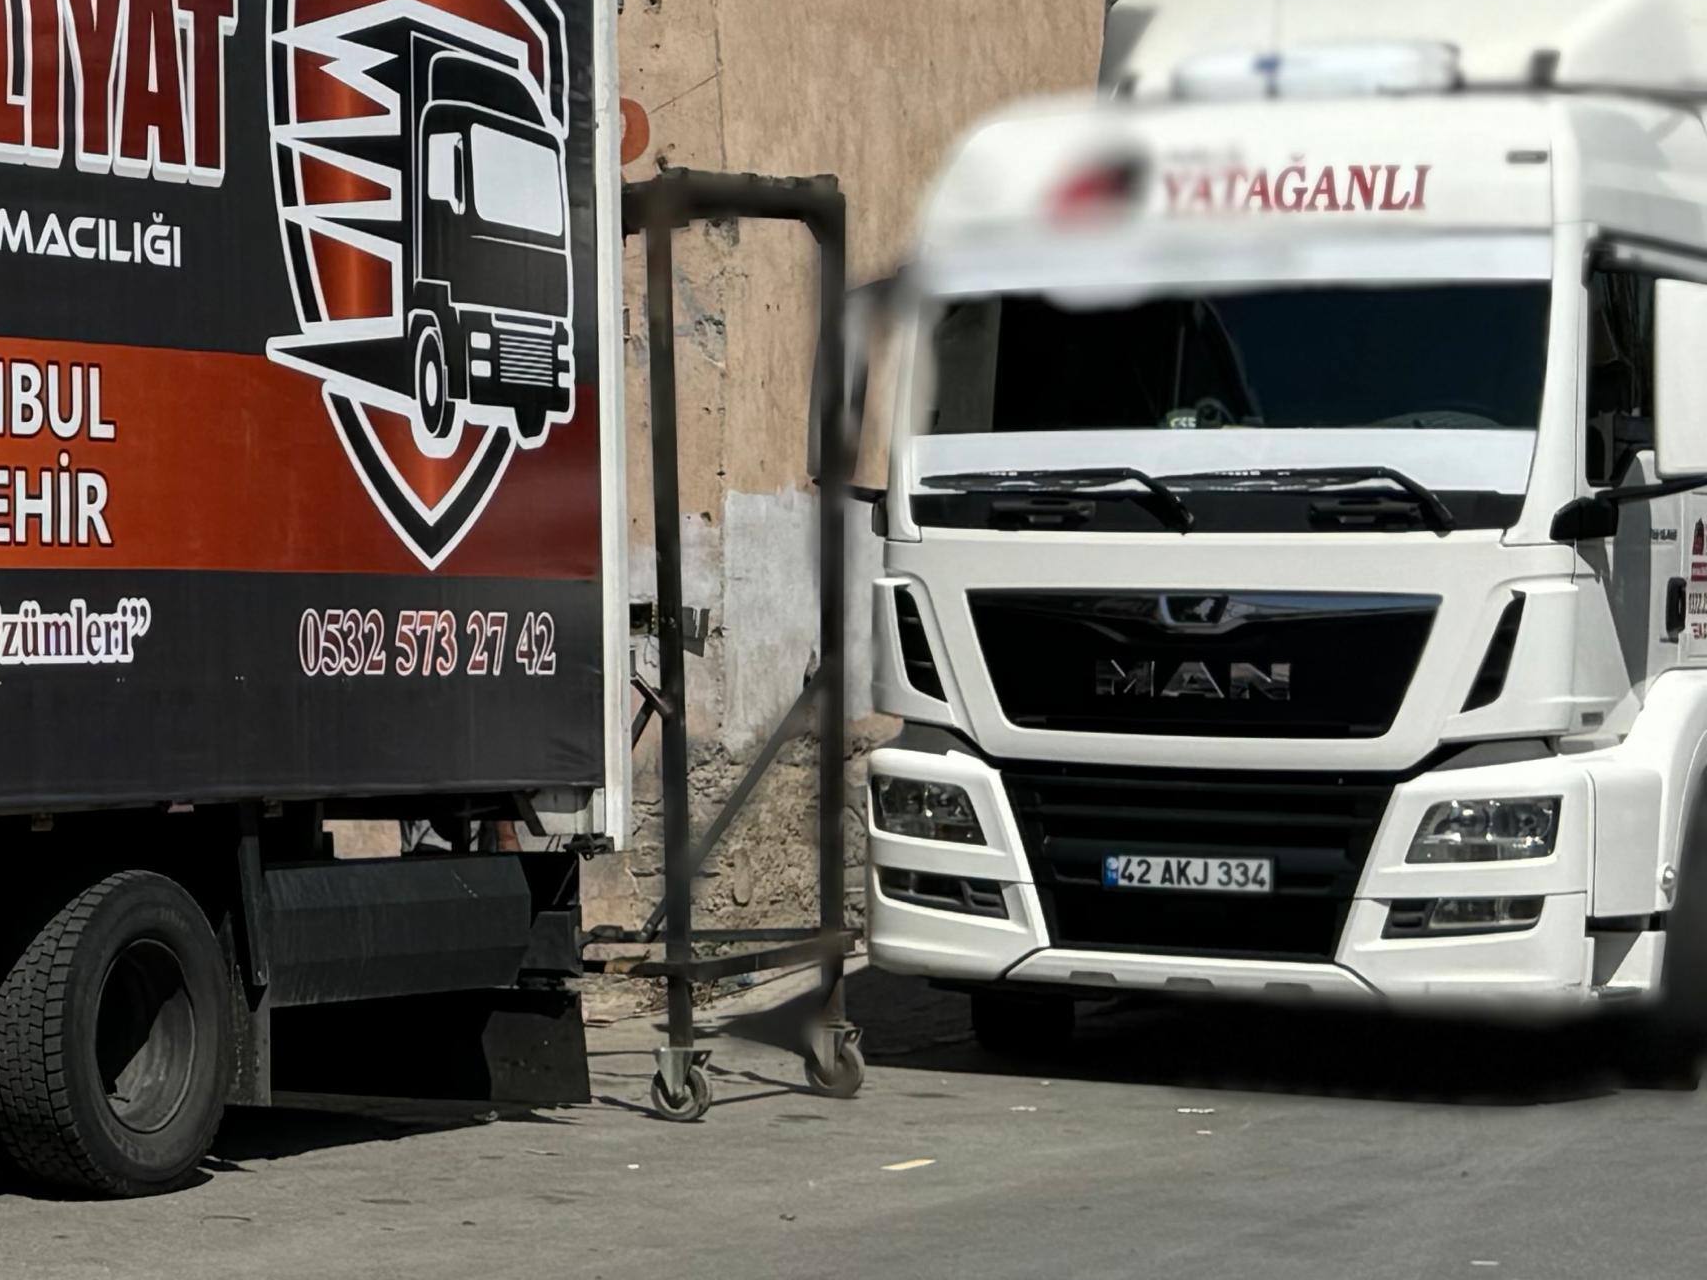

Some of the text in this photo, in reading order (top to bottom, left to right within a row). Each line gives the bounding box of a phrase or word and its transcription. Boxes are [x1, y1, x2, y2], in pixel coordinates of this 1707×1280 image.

[299, 608, 556, 676] 0532 573 27 42
[1096, 659, 1291, 701] MAN
[1120, 857, 1152, 885] 42
[1160, 859, 1210, 887] AKJ
[1217, 860, 1267, 889] 334
